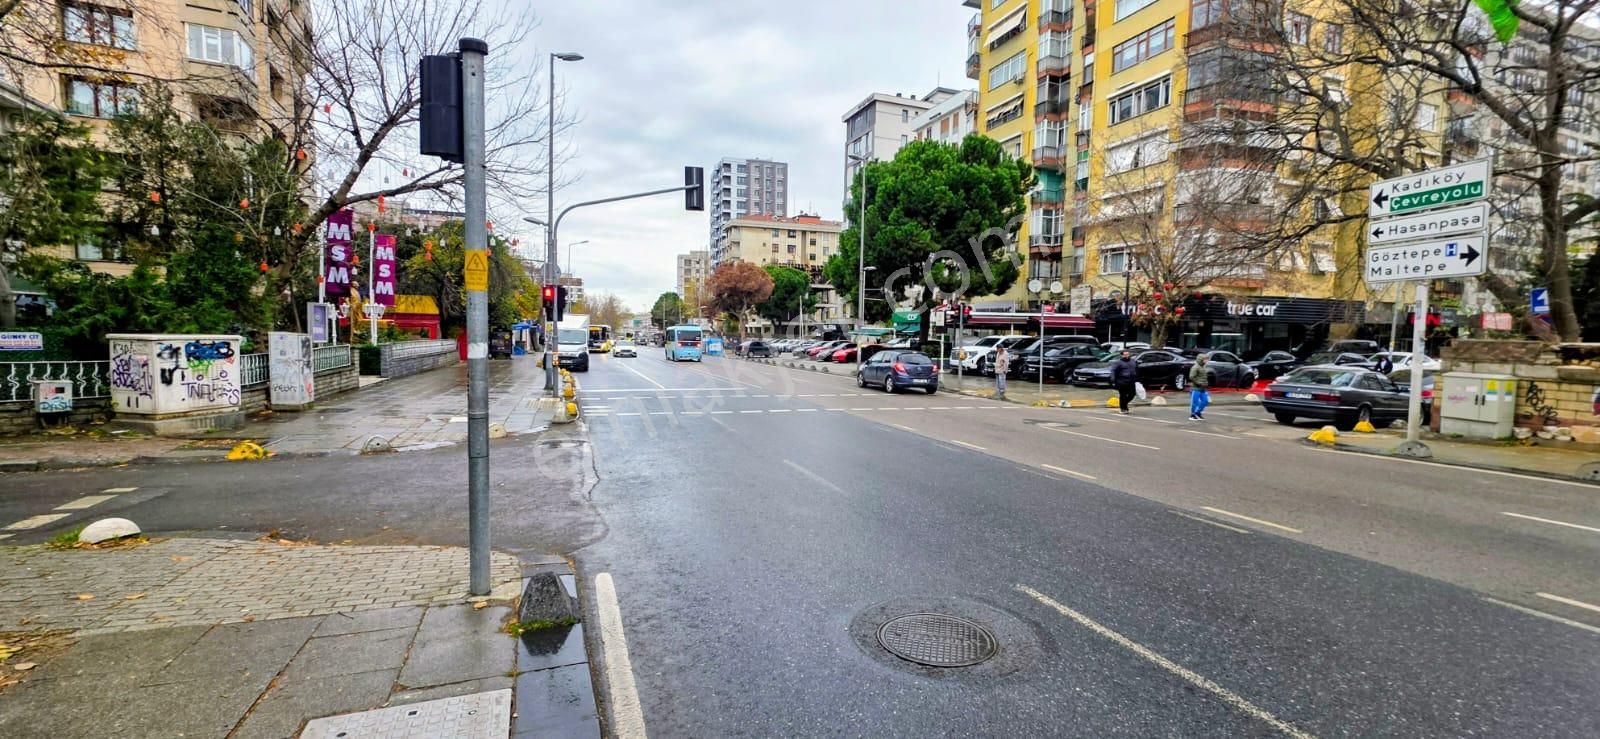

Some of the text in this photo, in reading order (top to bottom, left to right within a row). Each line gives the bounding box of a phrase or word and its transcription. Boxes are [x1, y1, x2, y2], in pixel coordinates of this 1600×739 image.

[1391, 171, 1466, 194] Kadıköy
[1390, 183, 1482, 209] Çevreyolu
[1388, 215, 1481, 236] Hasanpaşa
[327, 222, 351, 284] MSM
[1371, 247, 1442, 263] Göztepe
[375, 246, 395, 296] MSM
[1371, 263, 1447, 277] Maltepe
[1227, 300, 1254, 316] true
